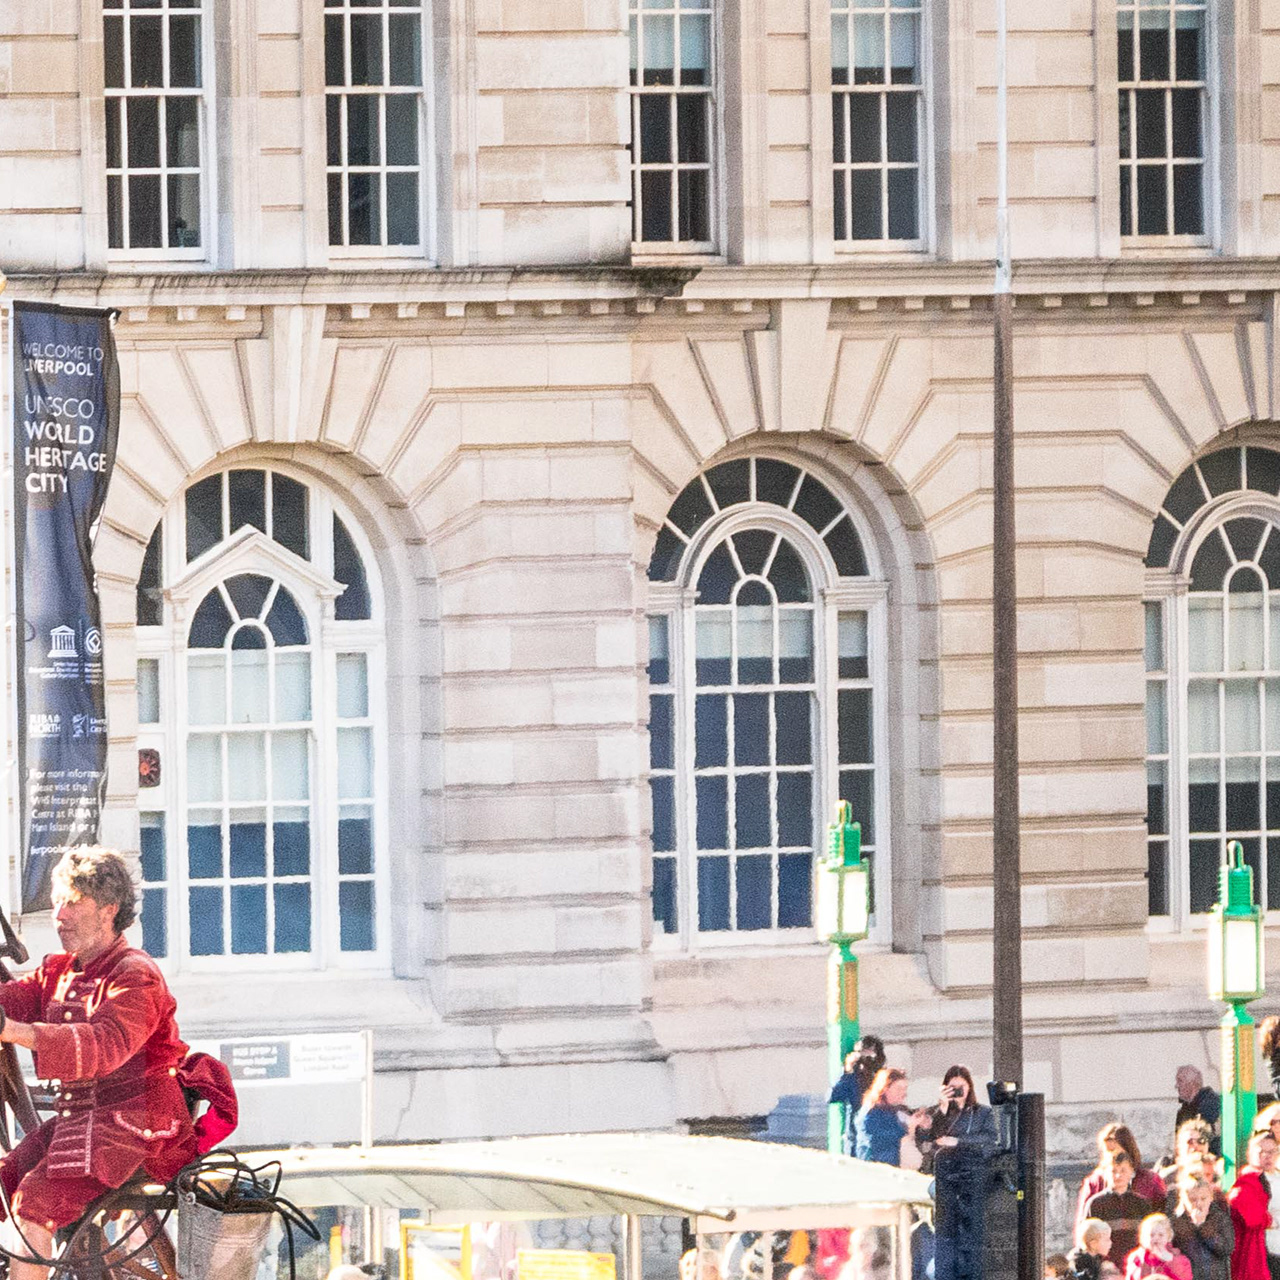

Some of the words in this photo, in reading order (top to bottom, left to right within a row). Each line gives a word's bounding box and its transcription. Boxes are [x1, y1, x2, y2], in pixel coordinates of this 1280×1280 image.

[23, 342, 84, 360] WELCOME
[88, 347, 104, 361] TO
[24, 420, 94, 444] WORLD
[25, 447, 107, 472] HERTAGE
[25, 473, 68, 493] CITY
